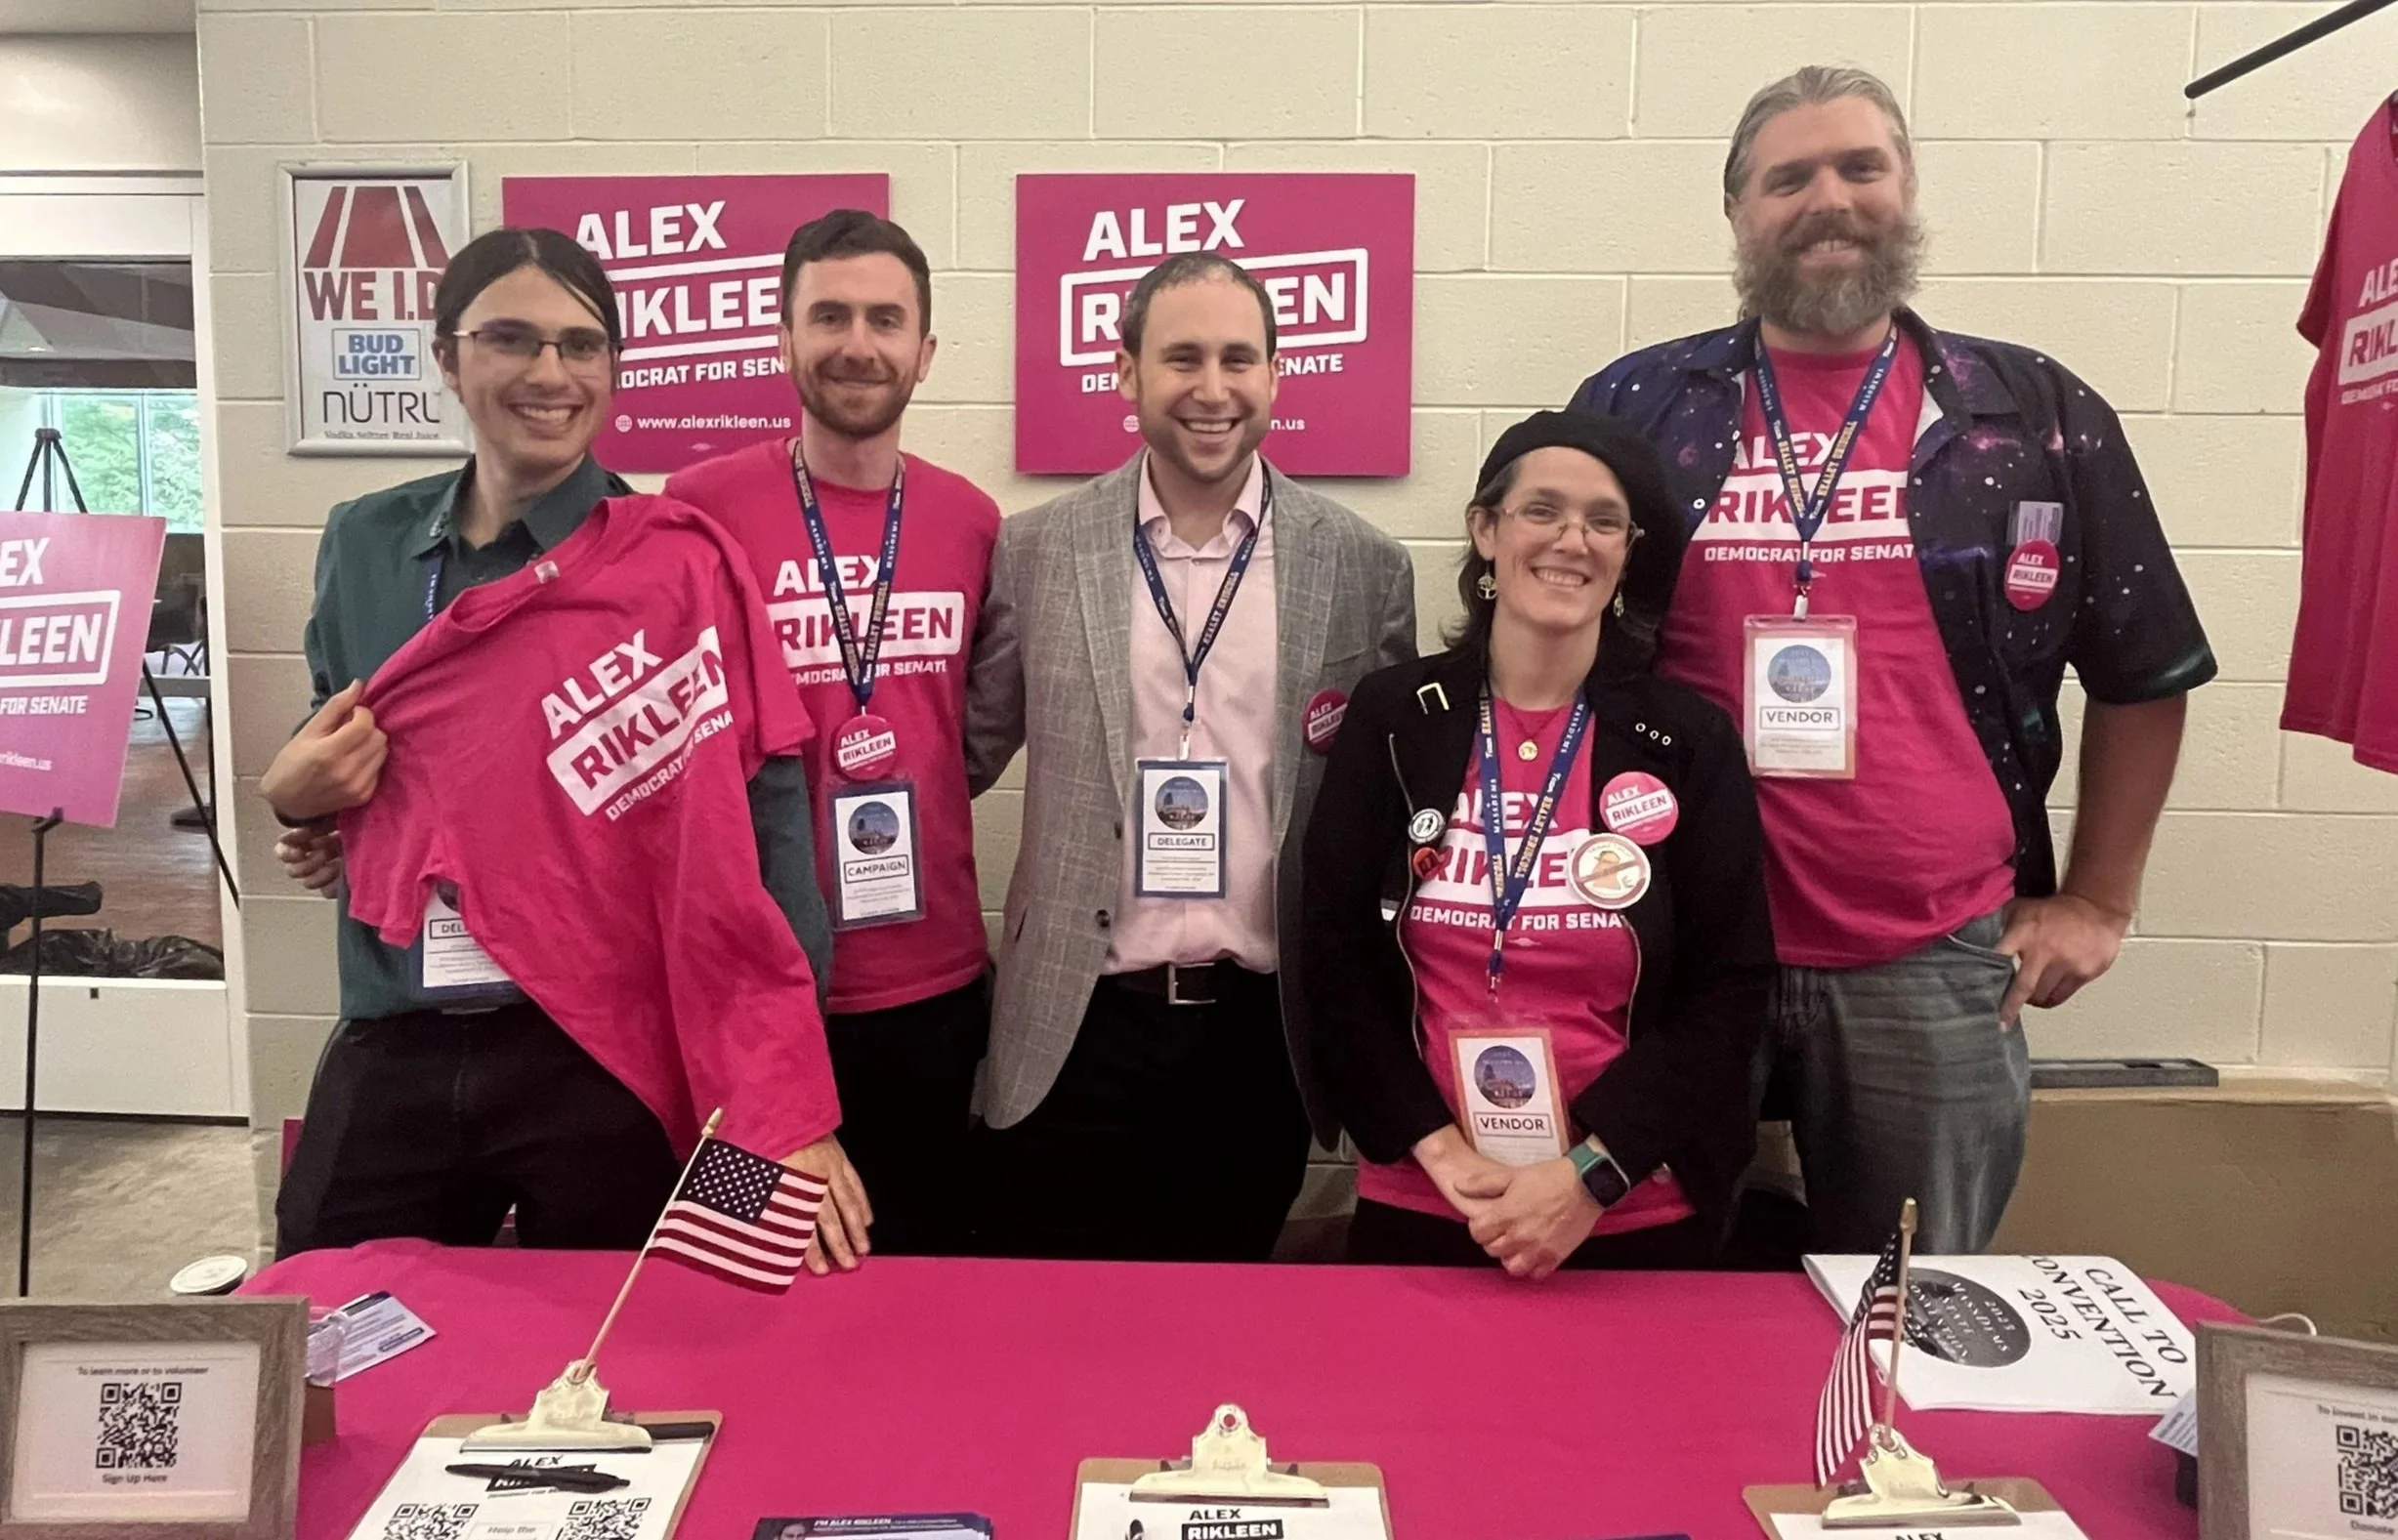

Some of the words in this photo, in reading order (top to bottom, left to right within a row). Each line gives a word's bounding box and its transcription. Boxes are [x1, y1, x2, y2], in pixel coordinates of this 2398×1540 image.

[575, 200, 727, 260] ALEX
[1082, 198, 1245, 262] ALEX
[303, 271, 378, 320] WE
[614, 276, 781, 339] IKLEE
[348, 334, 403, 354] BUD
[2349, 319, 2398, 367] RIKL
[338, 354, 415, 375] LIGHT
[619, 364, 690, 389] OCRAT
[695, 360, 737, 382] FOR
[742, 356, 786, 377] SEN
[1279, 354, 1343, 376] NATE
[637, 414, 791, 431] www.alexrikleen.us
[1709, 485, 1907, 523] RIKEE
[0, 537, 50, 586] EX
[1809, 548, 1845, 562] FOR
[1850, 544, 1915, 560] SENAT
[2017, 553, 2044, 565] ALEX
[773, 555, 881, 596] ALEX
[0, 613, 103, 666] LEEN
[541, 629, 663, 739] ALEX
[29, 695, 89, 715] SENATE
[694, 710, 735, 744] SENA
[1766, 711, 1833, 723] VENDOR
[841, 728, 871, 748] ALEX
[843, 737, 892, 762] RIKLEEN
[1608, 785, 1641, 807] ALEX
[1612, 796, 1667, 822] RIKLEEN
[1157, 837, 1207, 848] DELEGATE
[847, 859, 906, 877] CAMPAIGN
[1522, 914, 1560, 930] FOR
[1566, 912, 1622, 929] SENA
[1480, 1117, 1545, 1131] VENDOR
[2018, 1288, 2082, 1340] 2025
[2085, 1269, 2149, 1324] CALL
[2141, 1329, 2187, 1363] TO
[2032, 1258, 2178, 1398] ONVENTION
[77, 1367, 88, 1376] To
[115, 1367, 138, 1376] more
[508, 1454, 564, 1469] ALEX
[102, 1474, 123, 1484] Sign
[127, 1474, 141, 1483] Up
[1189, 1508, 1241, 1520] ALEX
[1188, 1522, 1278, 1540] RIKLEEN
